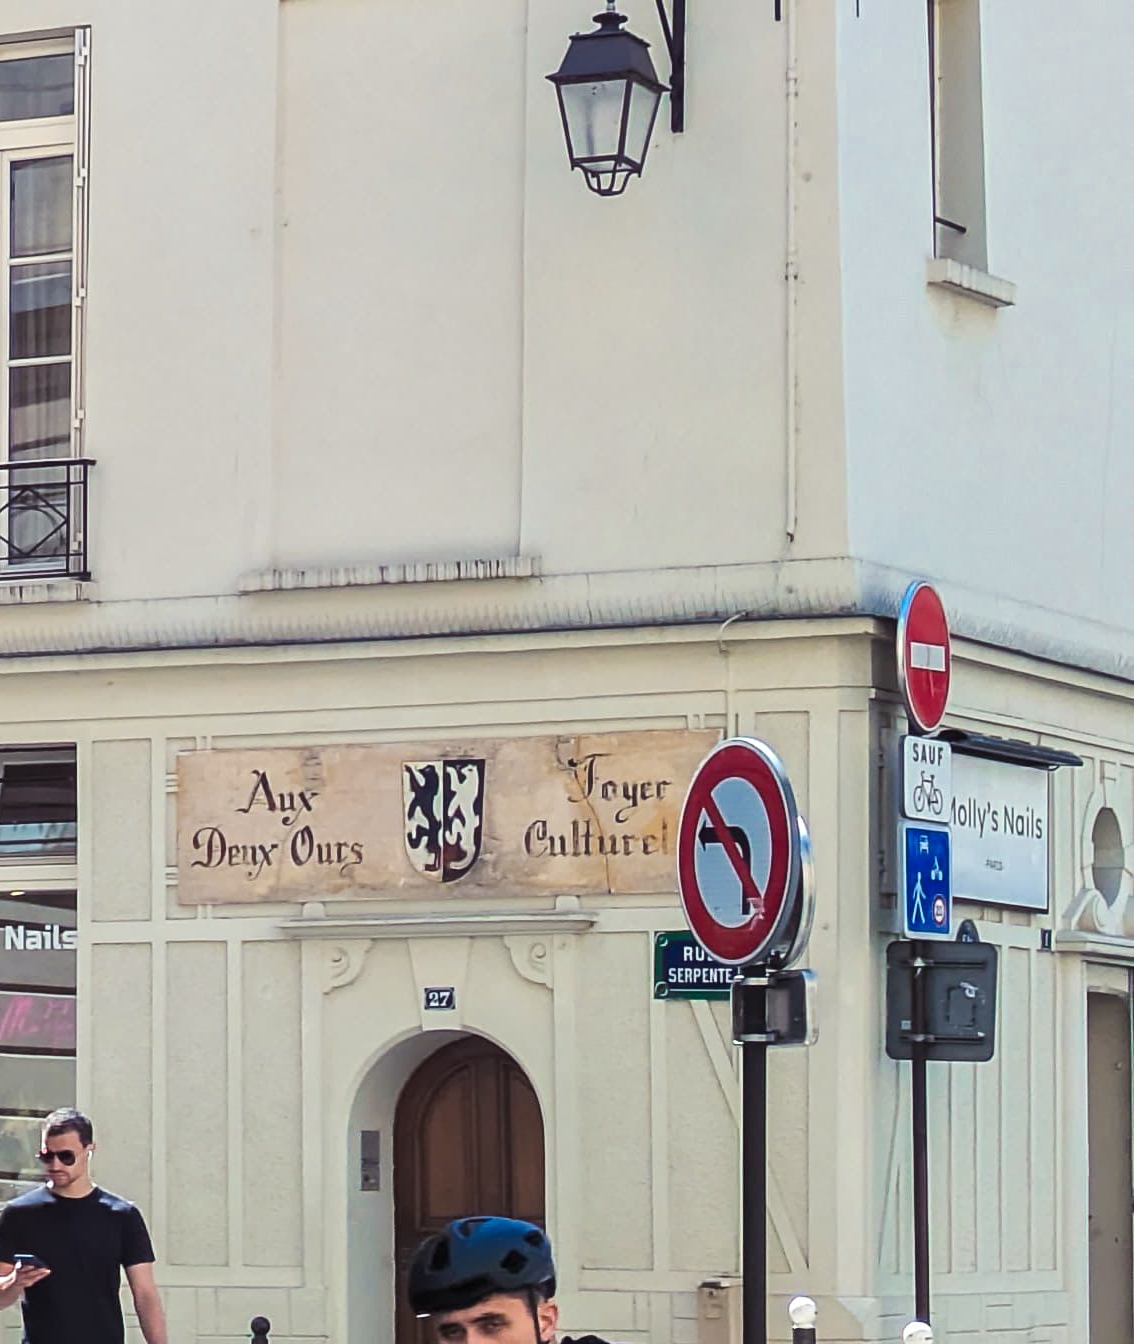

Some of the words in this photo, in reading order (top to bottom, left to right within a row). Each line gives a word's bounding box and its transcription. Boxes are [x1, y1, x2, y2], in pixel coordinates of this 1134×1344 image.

[912, 742, 944, 767] SAUF
[234, 769, 321, 826] Aux
[567, 753, 673, 824] Foyer
[524, 818, 668, 858] Culturel
[1003, 805, 1043, 840] Nails
[191, 826, 279, 882] Deux
[290, 825, 364, 878] Ours
[4, 924, 78, 951] Nails
[668, 967, 733, 983] SERPENTE
[428, 991, 451, 1007] 27
